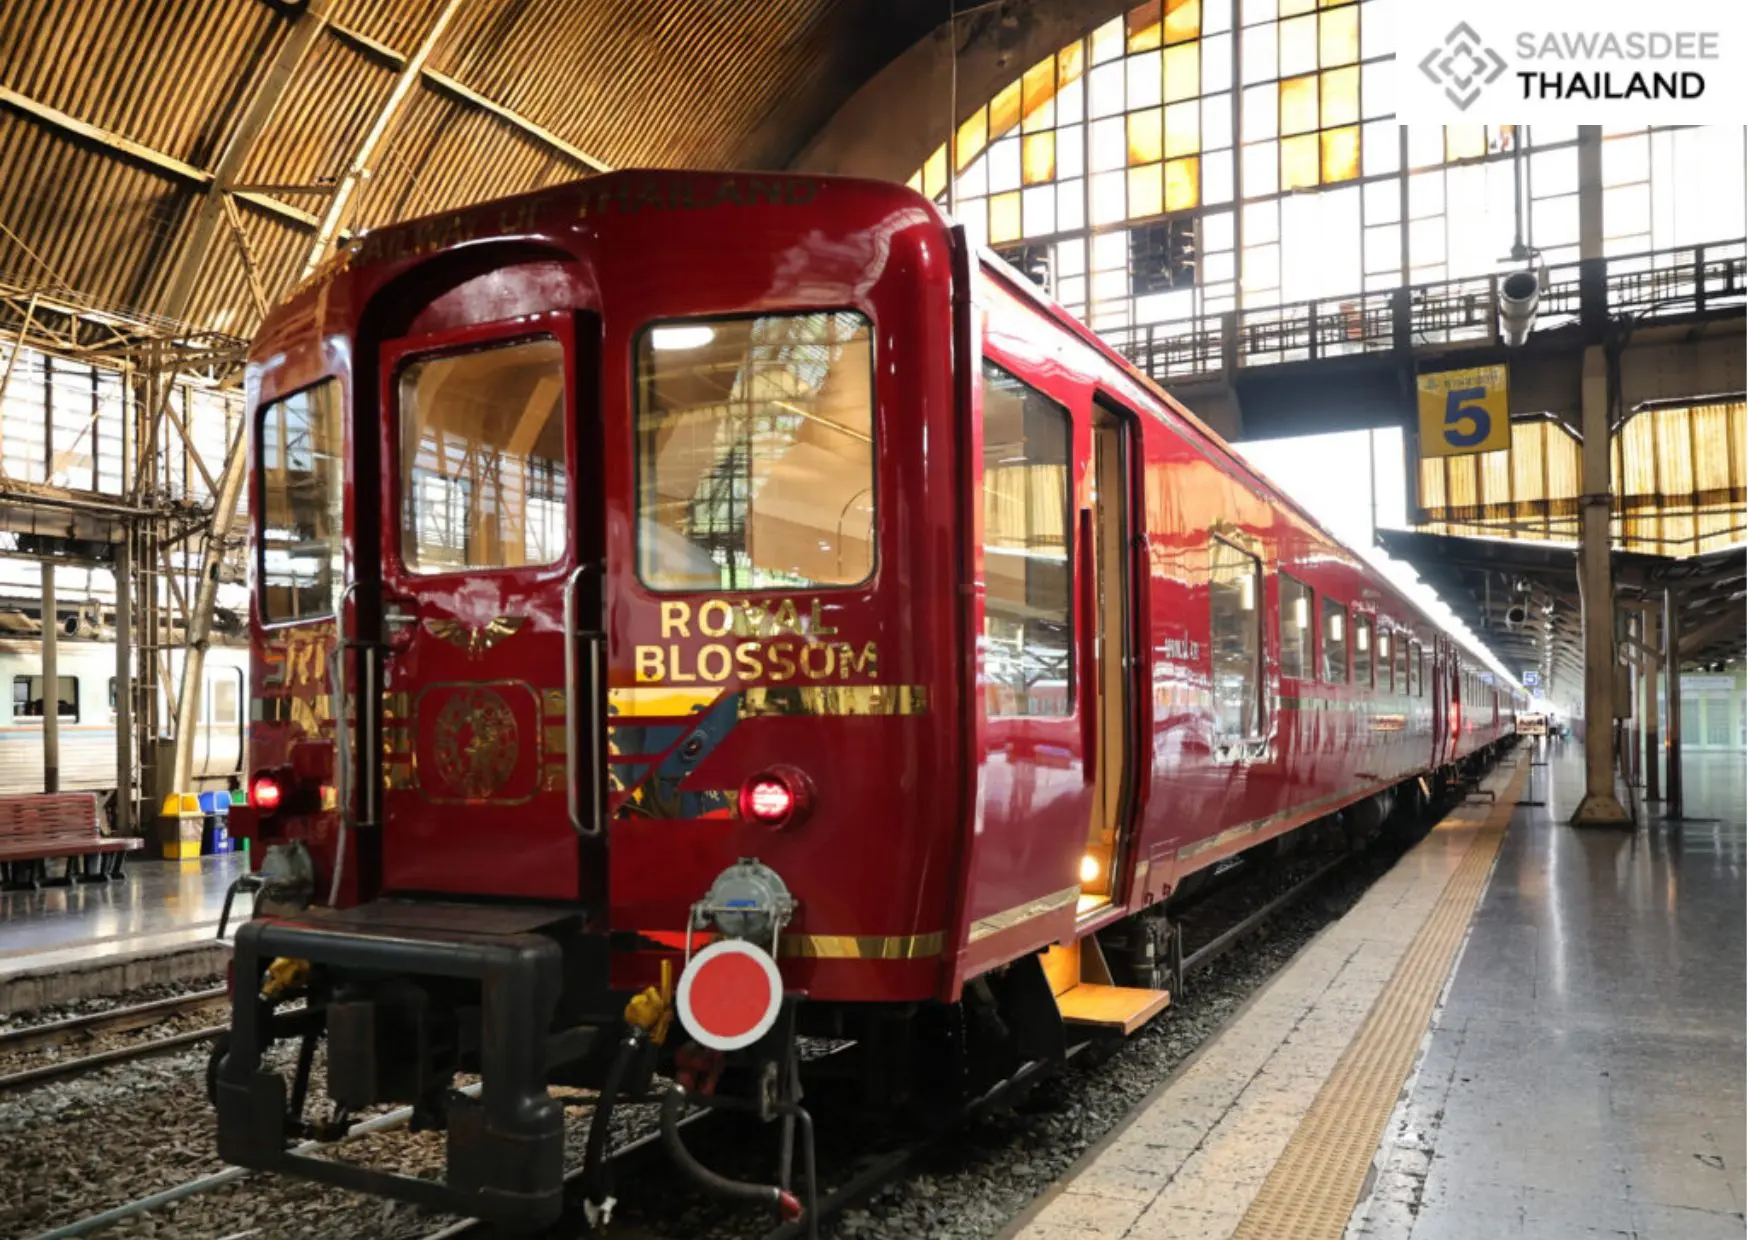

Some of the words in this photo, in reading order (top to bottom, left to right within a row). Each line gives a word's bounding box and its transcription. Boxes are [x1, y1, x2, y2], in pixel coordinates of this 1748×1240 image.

[1443, 386, 1492, 448] 5
[660, 598, 838, 639] ROYAL
[634, 641, 878, 682] BLOSSOM
